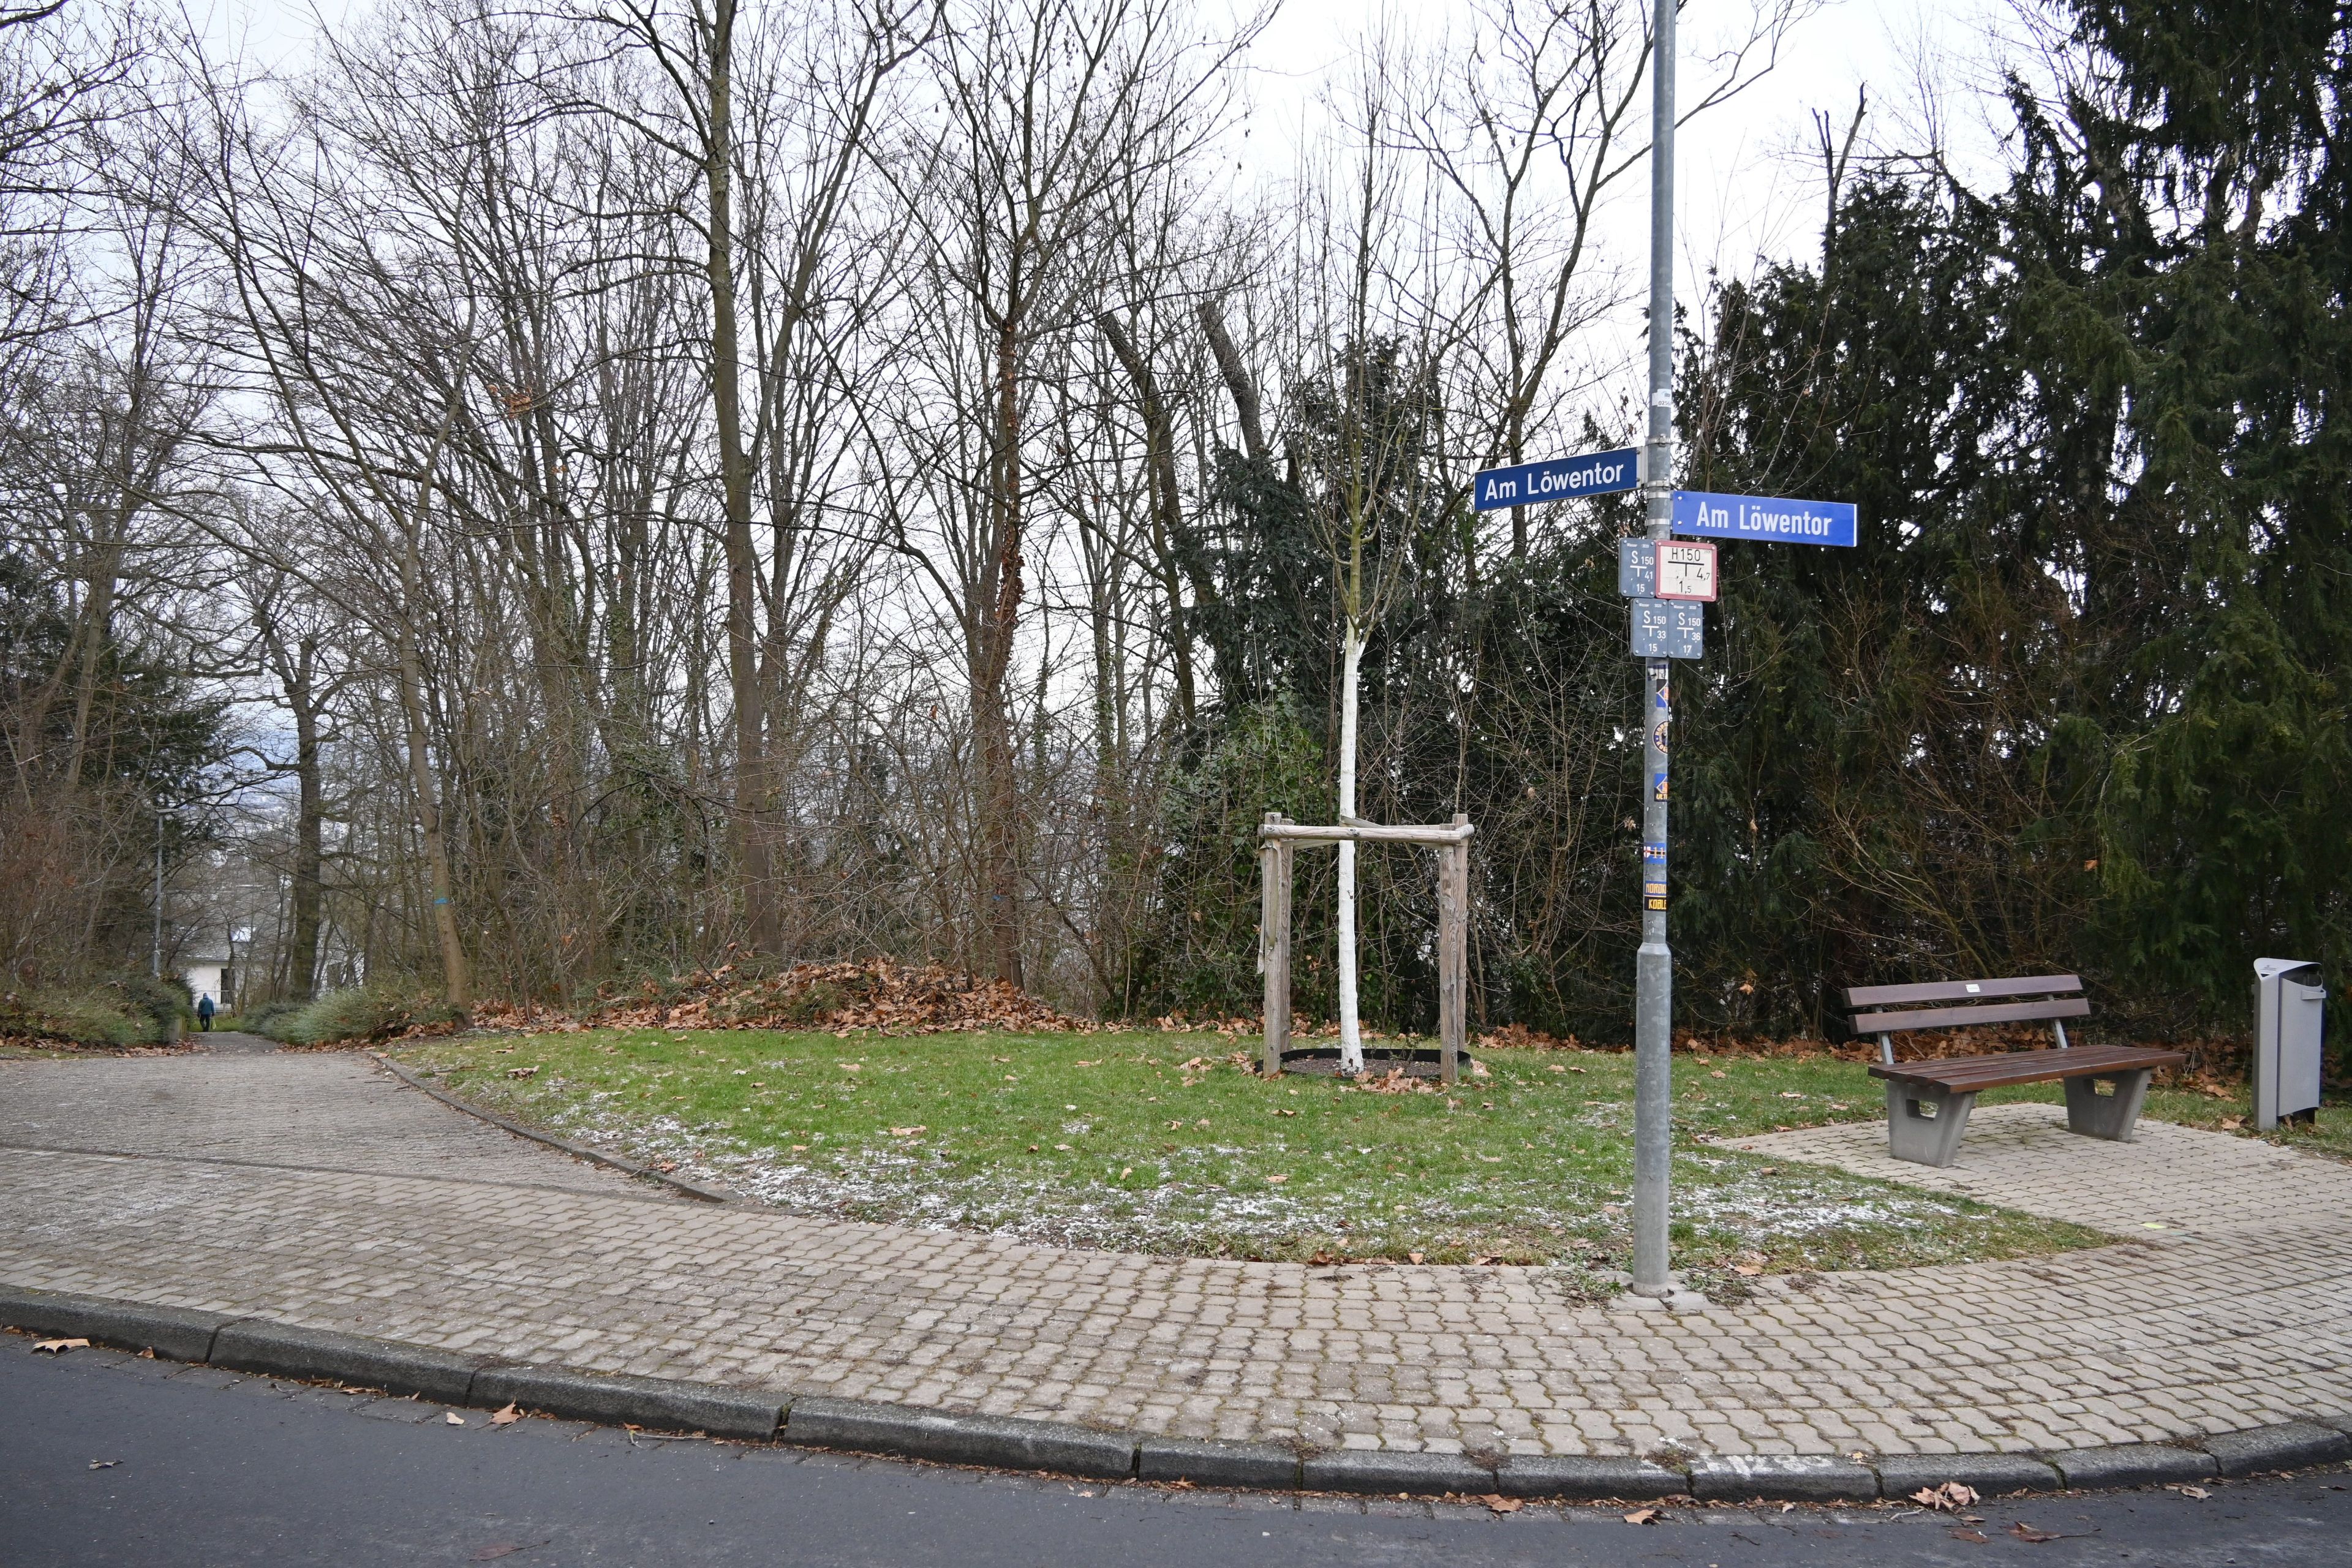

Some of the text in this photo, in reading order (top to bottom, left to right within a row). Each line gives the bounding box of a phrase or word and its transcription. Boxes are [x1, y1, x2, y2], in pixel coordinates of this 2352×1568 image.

[1485, 462, 1624, 501] Am Löwentor
[1696, 501, 1832, 536] Am Löwentor
[1631, 550, 1654, 565] S 150
[1696, 567, 1710, 581] 4,7
[1679, 580, 1692, 594] 1,5
[1643, 610, 1666, 625] S 150
[1678, 612, 1701, 627] S 150
